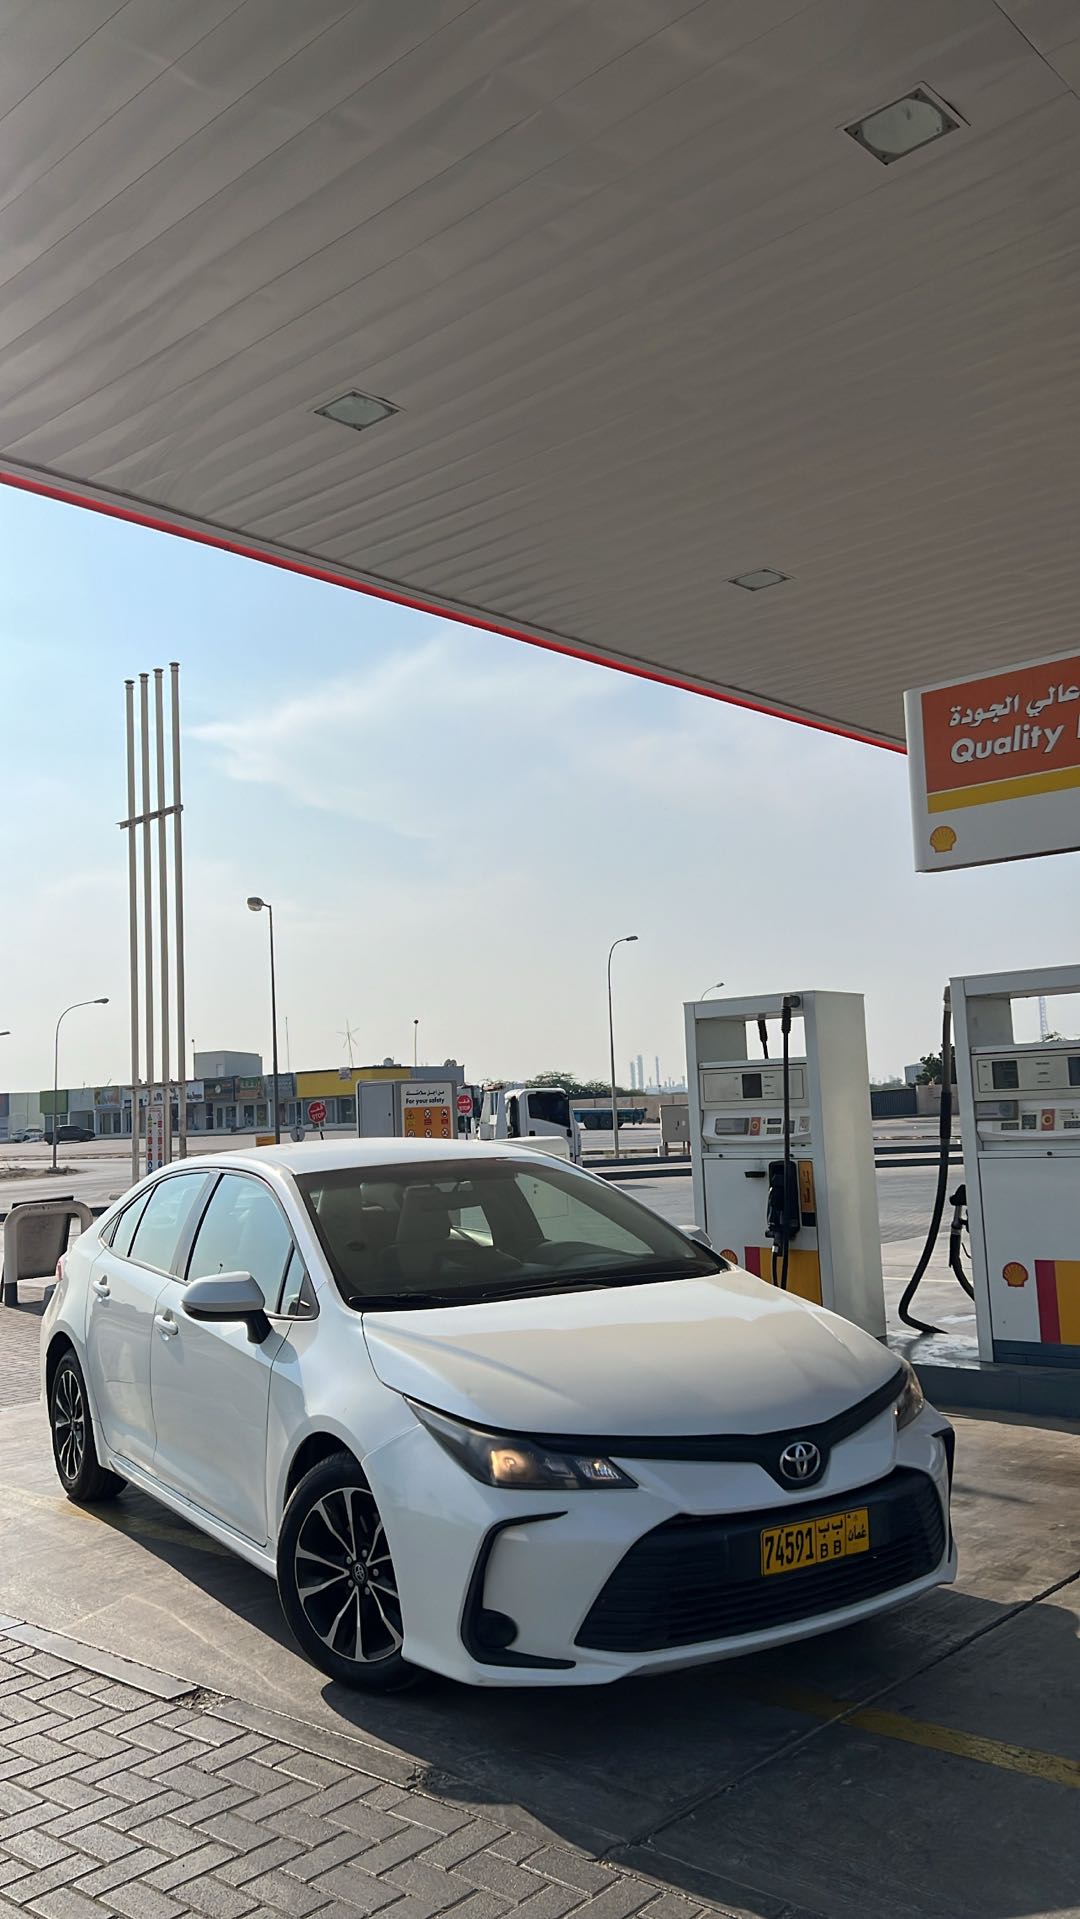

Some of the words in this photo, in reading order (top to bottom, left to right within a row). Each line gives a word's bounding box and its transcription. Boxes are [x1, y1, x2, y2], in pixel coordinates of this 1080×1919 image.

[949, 694, 1019, 728] الجودة
[950, 723, 1065, 764] Quality
[312, 1111, 325, 1120] STOP
[765, 1527, 814, 1570] 74591
[820, 1543, 828, 1558] B
[833, 1540, 842, 1555] B
